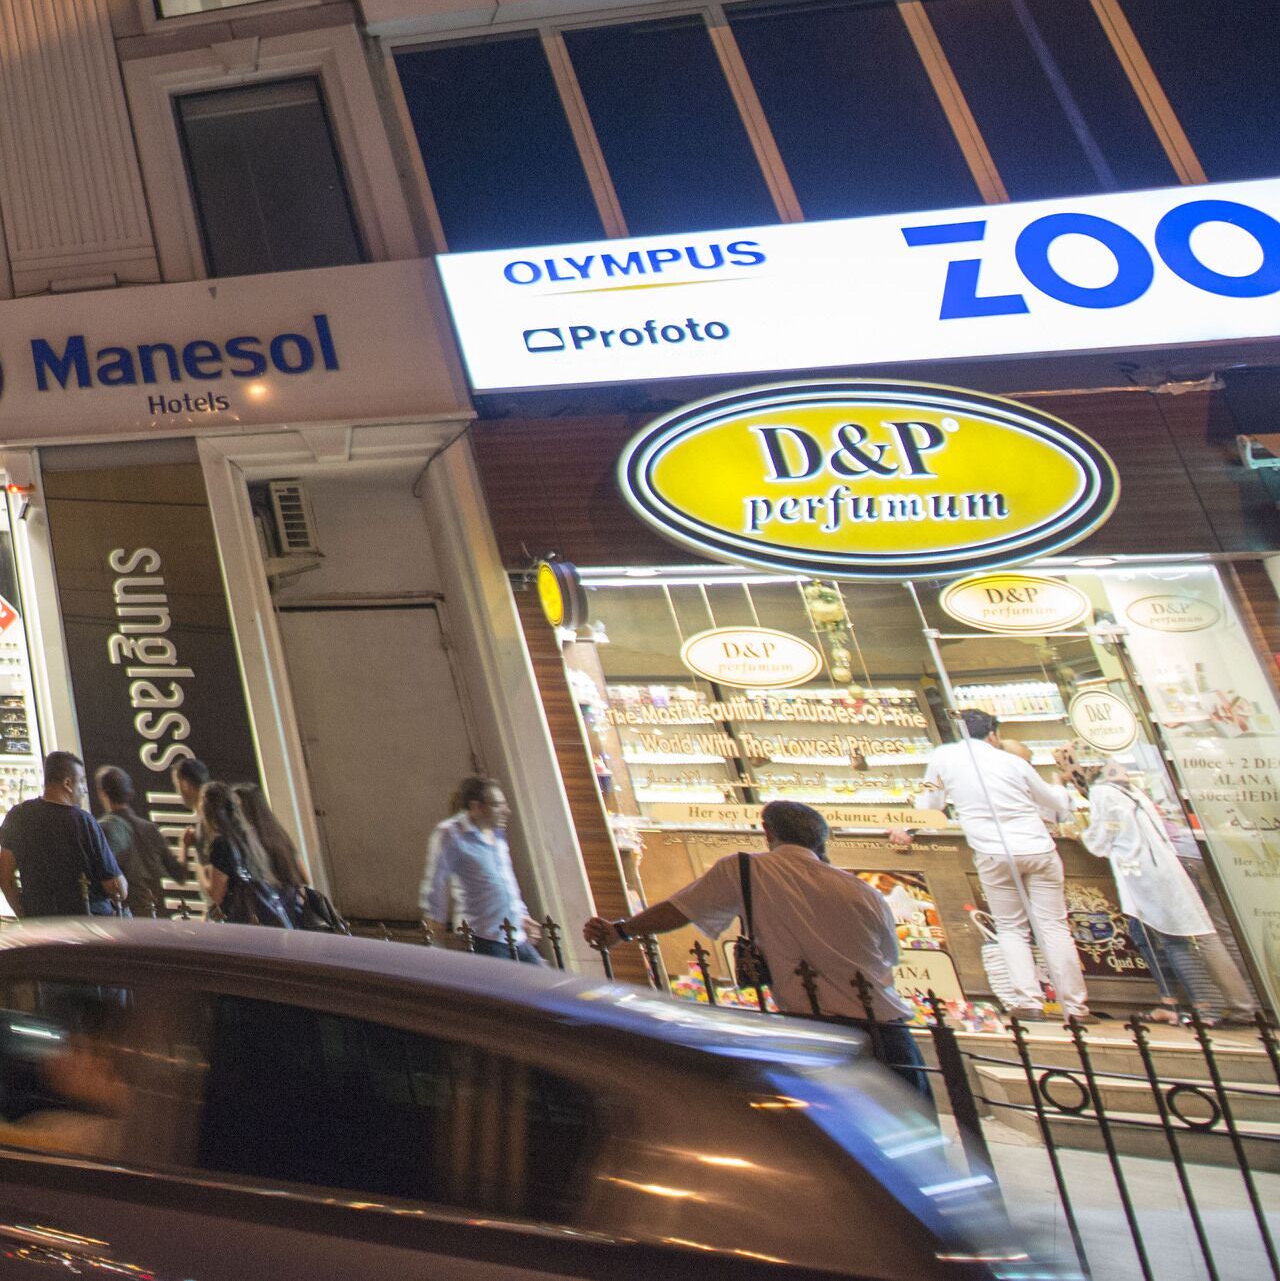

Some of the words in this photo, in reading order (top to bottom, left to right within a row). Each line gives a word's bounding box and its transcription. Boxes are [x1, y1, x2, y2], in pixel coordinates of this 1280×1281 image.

[503, 240, 767, 286] OLYMPUS
[571, 318, 730, 351] Profoto
[31, 314, 339, 392] Manesol
[148, 392, 230, 416] Hotels
[753, 418, 947, 482] D&P
[742, 485, 1011, 533] perfumum
[983, 586, 1039, 604] D&P
[1151, 603, 1191, 615] D&P
[107, 547, 196, 772] sunglass
[722, 642, 776, 659] D&P
[608, 708, 639, 726] The
[643, 703, 687, 725] Most
[689, 695, 766, 723] Beautiful
[770, 696, 859, 725] Perfumes
[862, 702, 888, 724] Of
[888, 706, 928, 729] The
[1084, 703, 1112, 722] D&P
[643, 733, 692, 755] World
[696, 733, 737, 757] With
[740, 734, 774, 759] The
[779, 734, 845, 759] Lowest
[848, 734, 906, 758] Prices
[1182, 758, 1222, 769] 100cc
[1240, 758, 1249, 769] 2
[1254, 758, 1280, 769] DE
[1214, 774, 1272, 785] ALANA
[688, 806, 714, 820] Her
